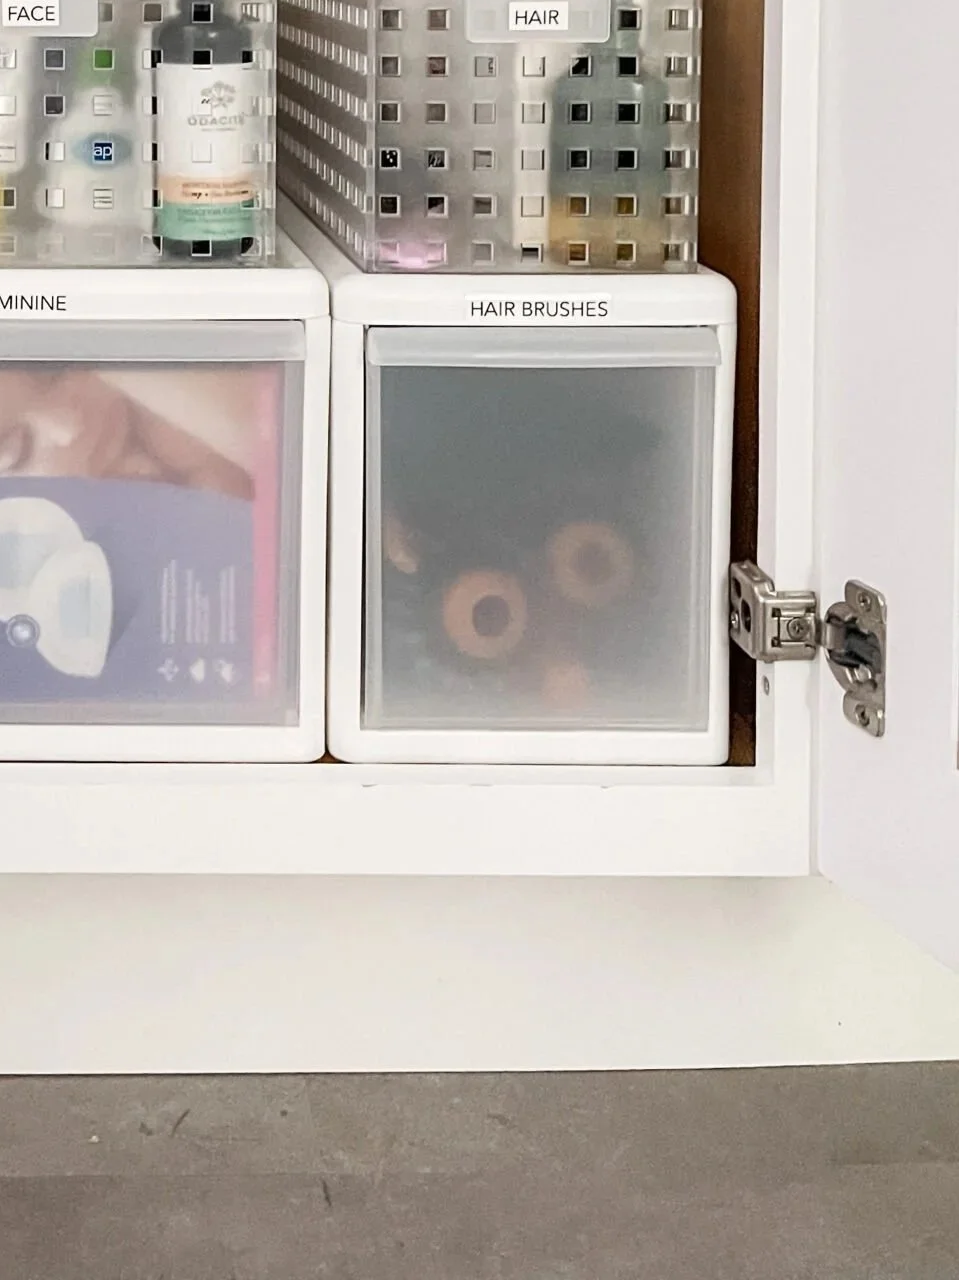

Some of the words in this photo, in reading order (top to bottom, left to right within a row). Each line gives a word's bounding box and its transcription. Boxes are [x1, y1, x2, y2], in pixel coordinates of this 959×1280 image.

[8, 5, 55, 22] FACE
[515, 9, 559, 25] HAIR
[471, 301, 516, 317] HAIR
[522, 301, 608, 317] BRUSHES
